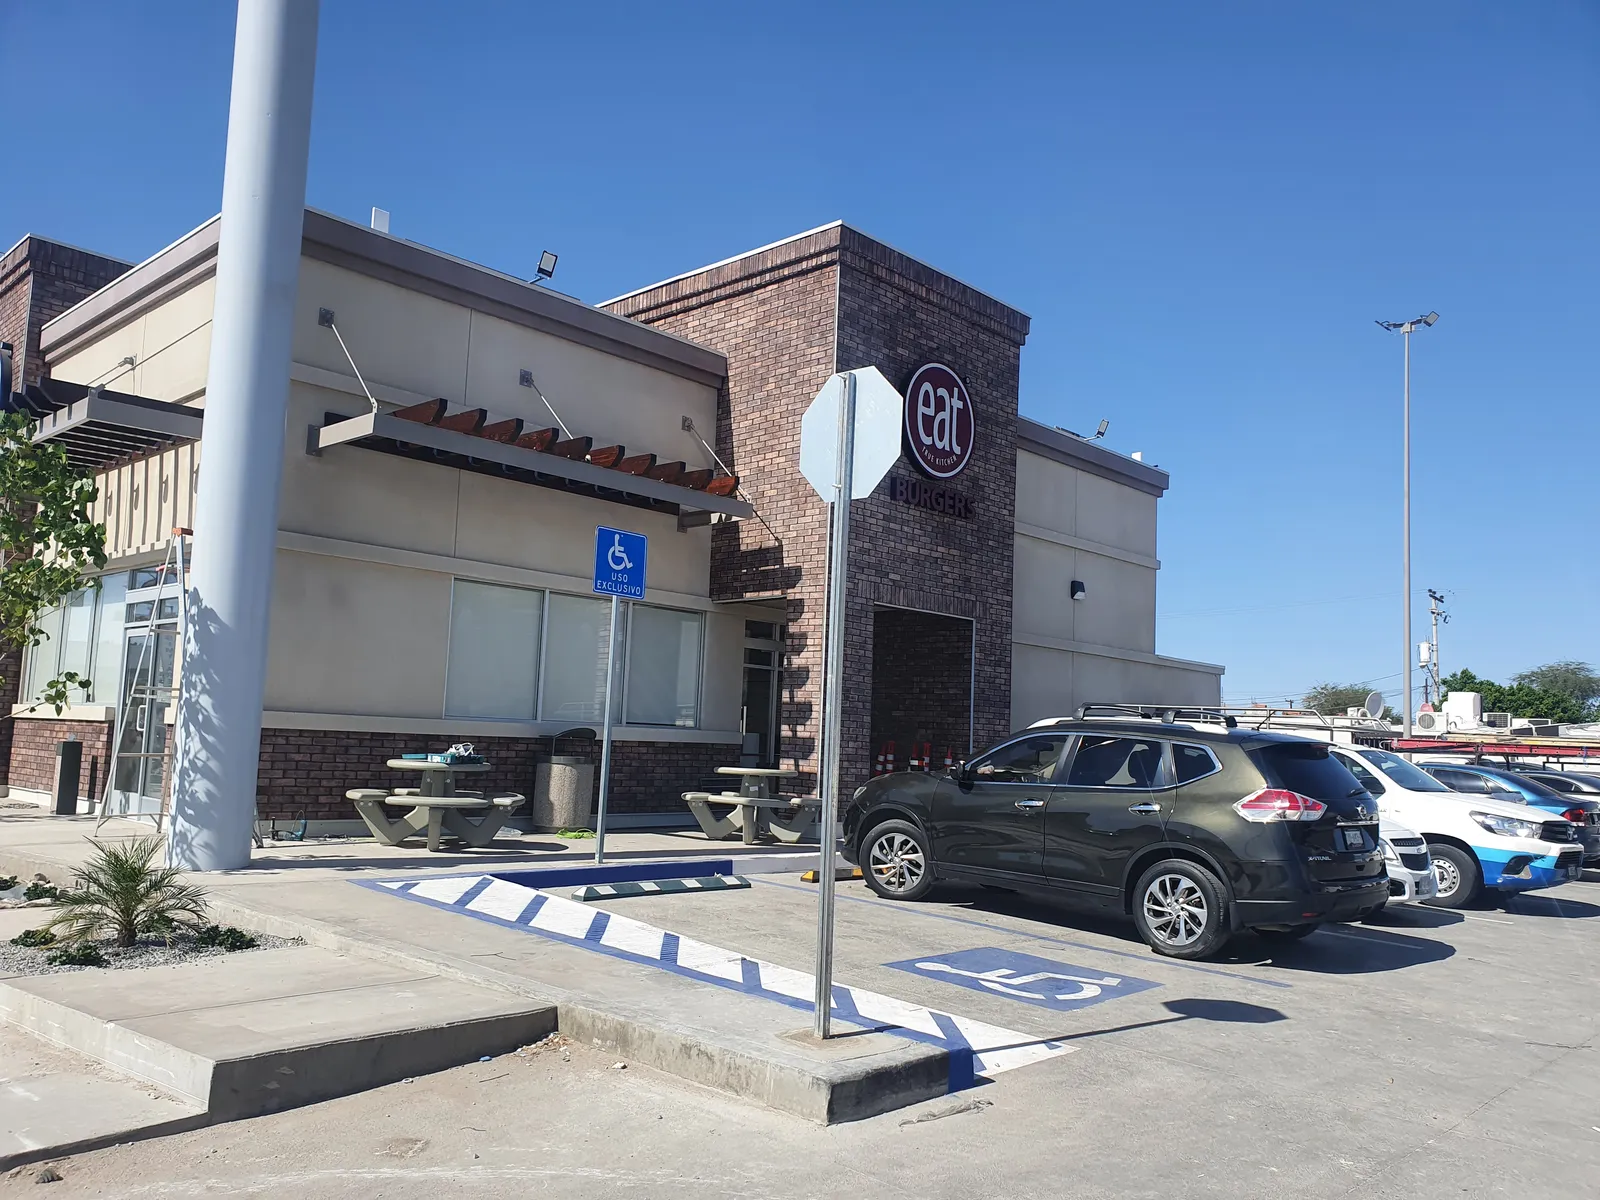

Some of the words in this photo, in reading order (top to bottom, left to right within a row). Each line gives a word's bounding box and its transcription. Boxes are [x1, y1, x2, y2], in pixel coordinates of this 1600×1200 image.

[917, 381, 964, 455] eat
[921, 446, 934, 464] TRUE
[936, 454, 958, 466] KITCHEN
[896, 477, 976, 519] BURGERS
[597, 580, 641, 595] EXCLUSIVO
[612, 573, 628, 582] USO
